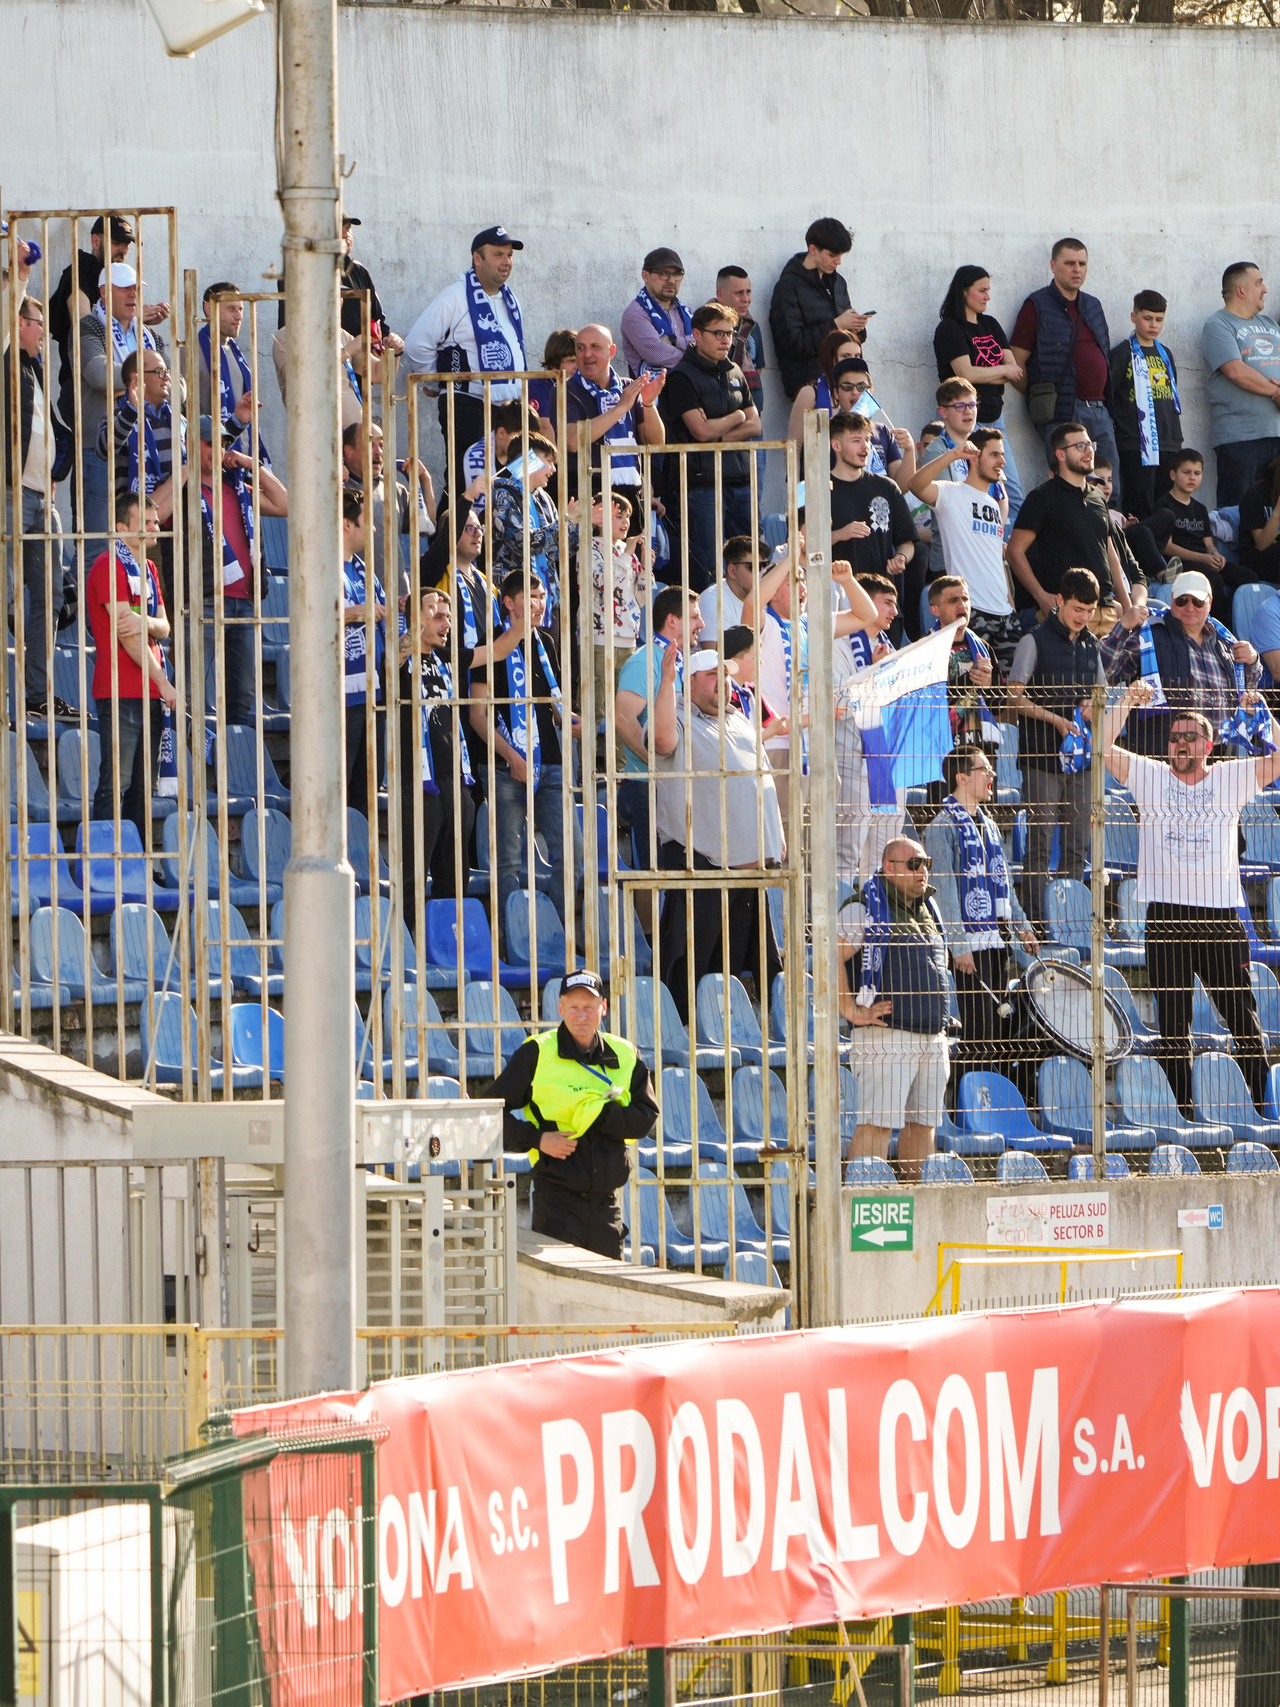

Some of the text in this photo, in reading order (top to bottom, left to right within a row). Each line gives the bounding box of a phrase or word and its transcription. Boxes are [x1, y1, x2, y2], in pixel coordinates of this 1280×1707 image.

[972, 519, 997, 536] DON
[1050, 1202, 1107, 1219] PELUZA SUD
[1210, 1211, 1221, 1223] WC
[1053, 1224, 1104, 1240] SECTOR B
[280, 1485, 475, 1630] VOONA
[488, 1485, 539, 1556] S.C.
[541, 1366, 1061, 1605] PRODALCOM
[1072, 1411, 1146, 1477] S.A.
